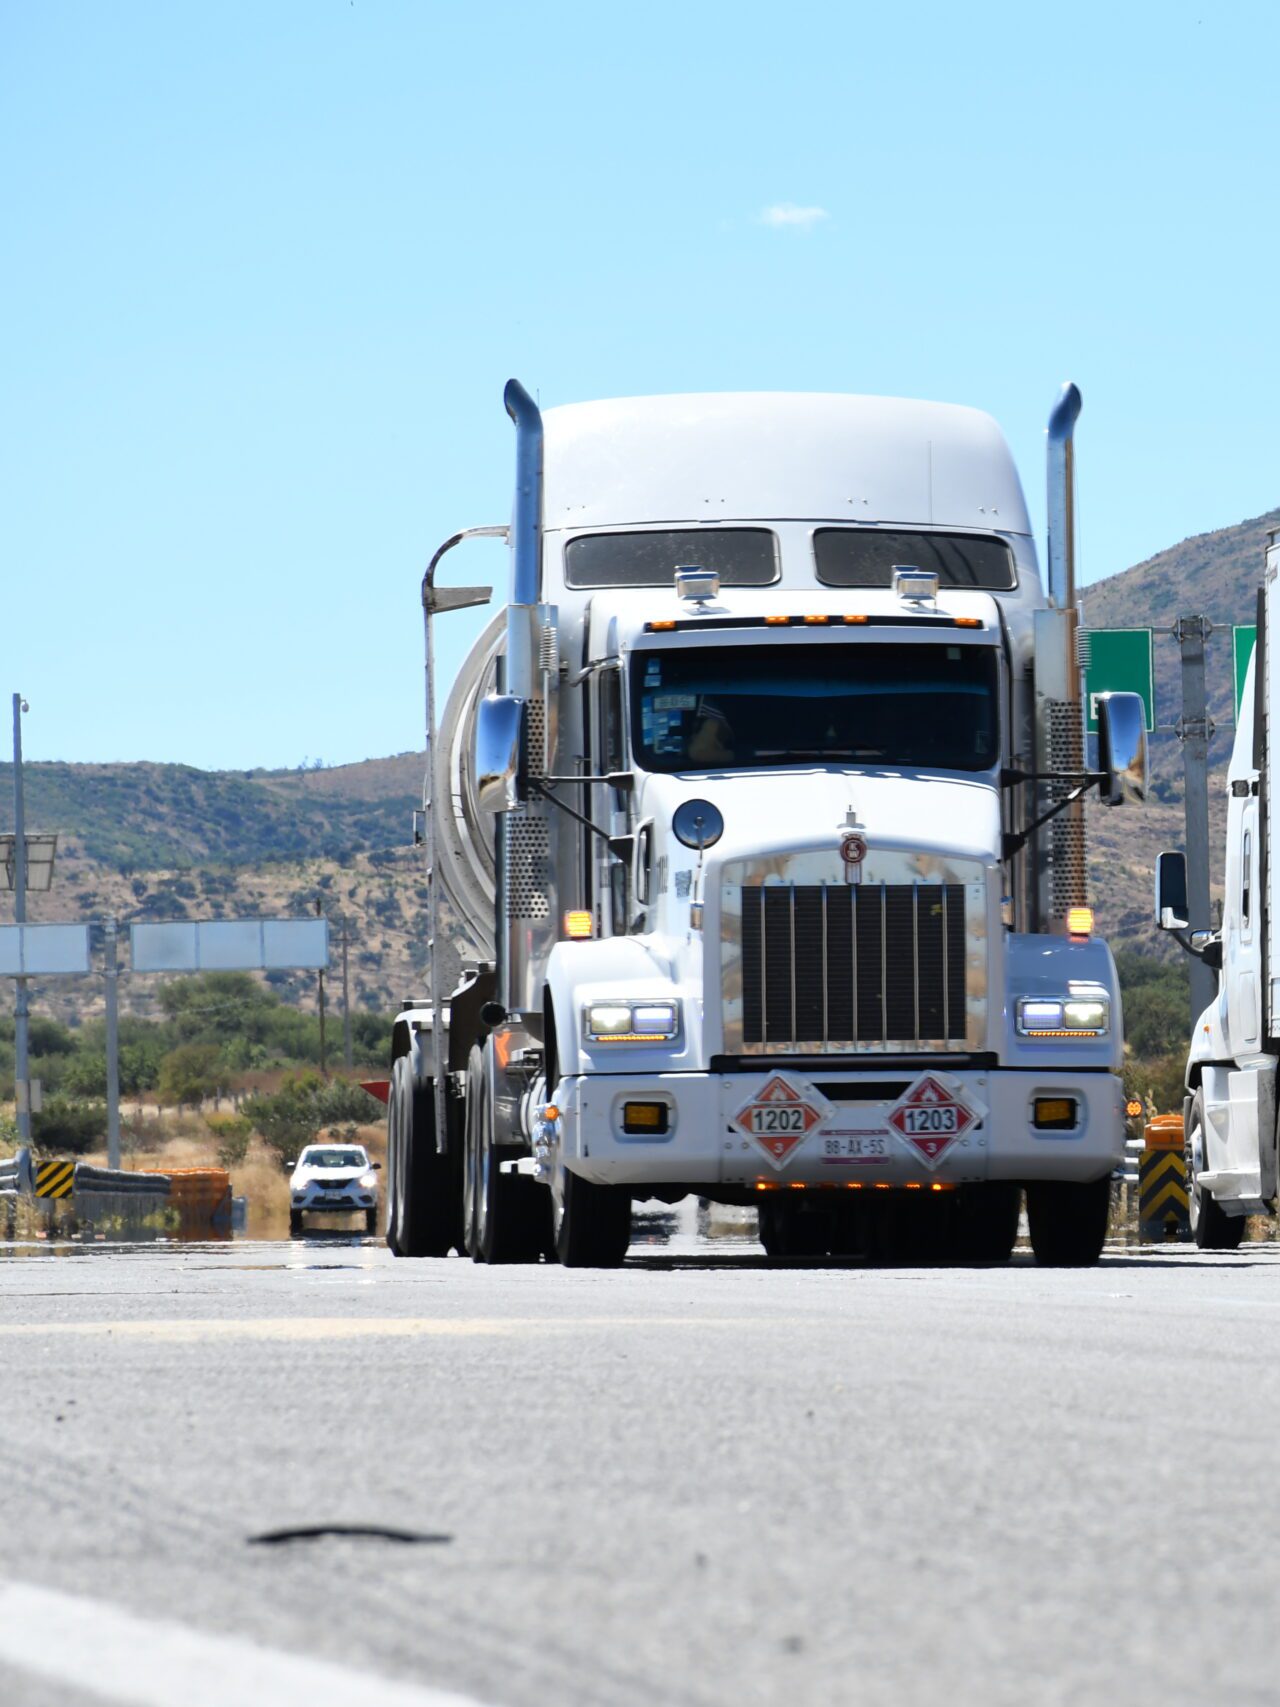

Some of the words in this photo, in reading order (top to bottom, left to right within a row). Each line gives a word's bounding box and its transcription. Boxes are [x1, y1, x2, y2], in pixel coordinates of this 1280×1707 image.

[753, 1109, 803, 1131] 1202
[906, 1108, 955, 1131] 1203
[773, 1142, 784, 1154] 3
[926, 1142, 937, 1154] 3
